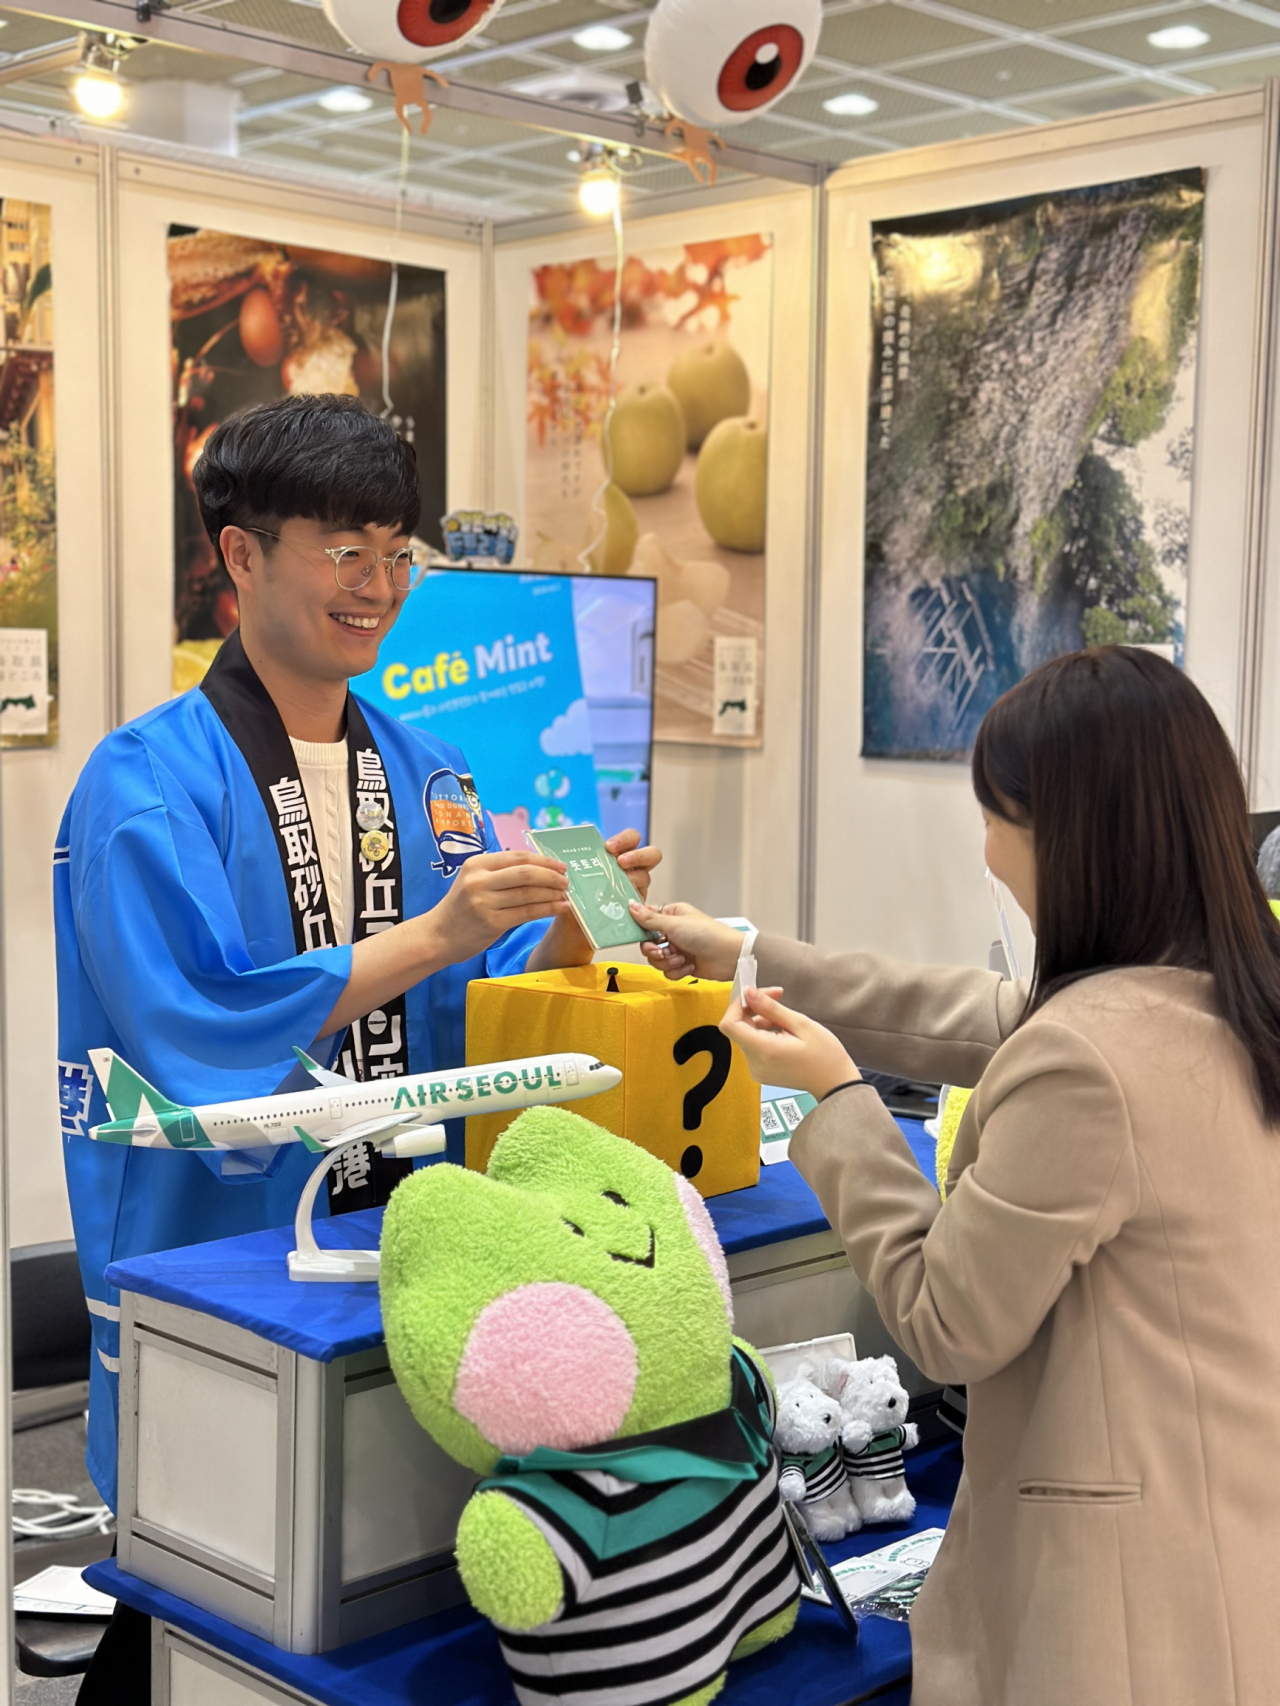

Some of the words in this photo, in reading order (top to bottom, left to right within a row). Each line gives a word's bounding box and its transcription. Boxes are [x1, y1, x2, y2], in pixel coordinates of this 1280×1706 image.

[474, 632, 553, 679] Mint
[569, 856, 604, 872] 돗토리
[393, 1081, 450, 1110] AIR
[455, 1065, 562, 1101] SEOUL
